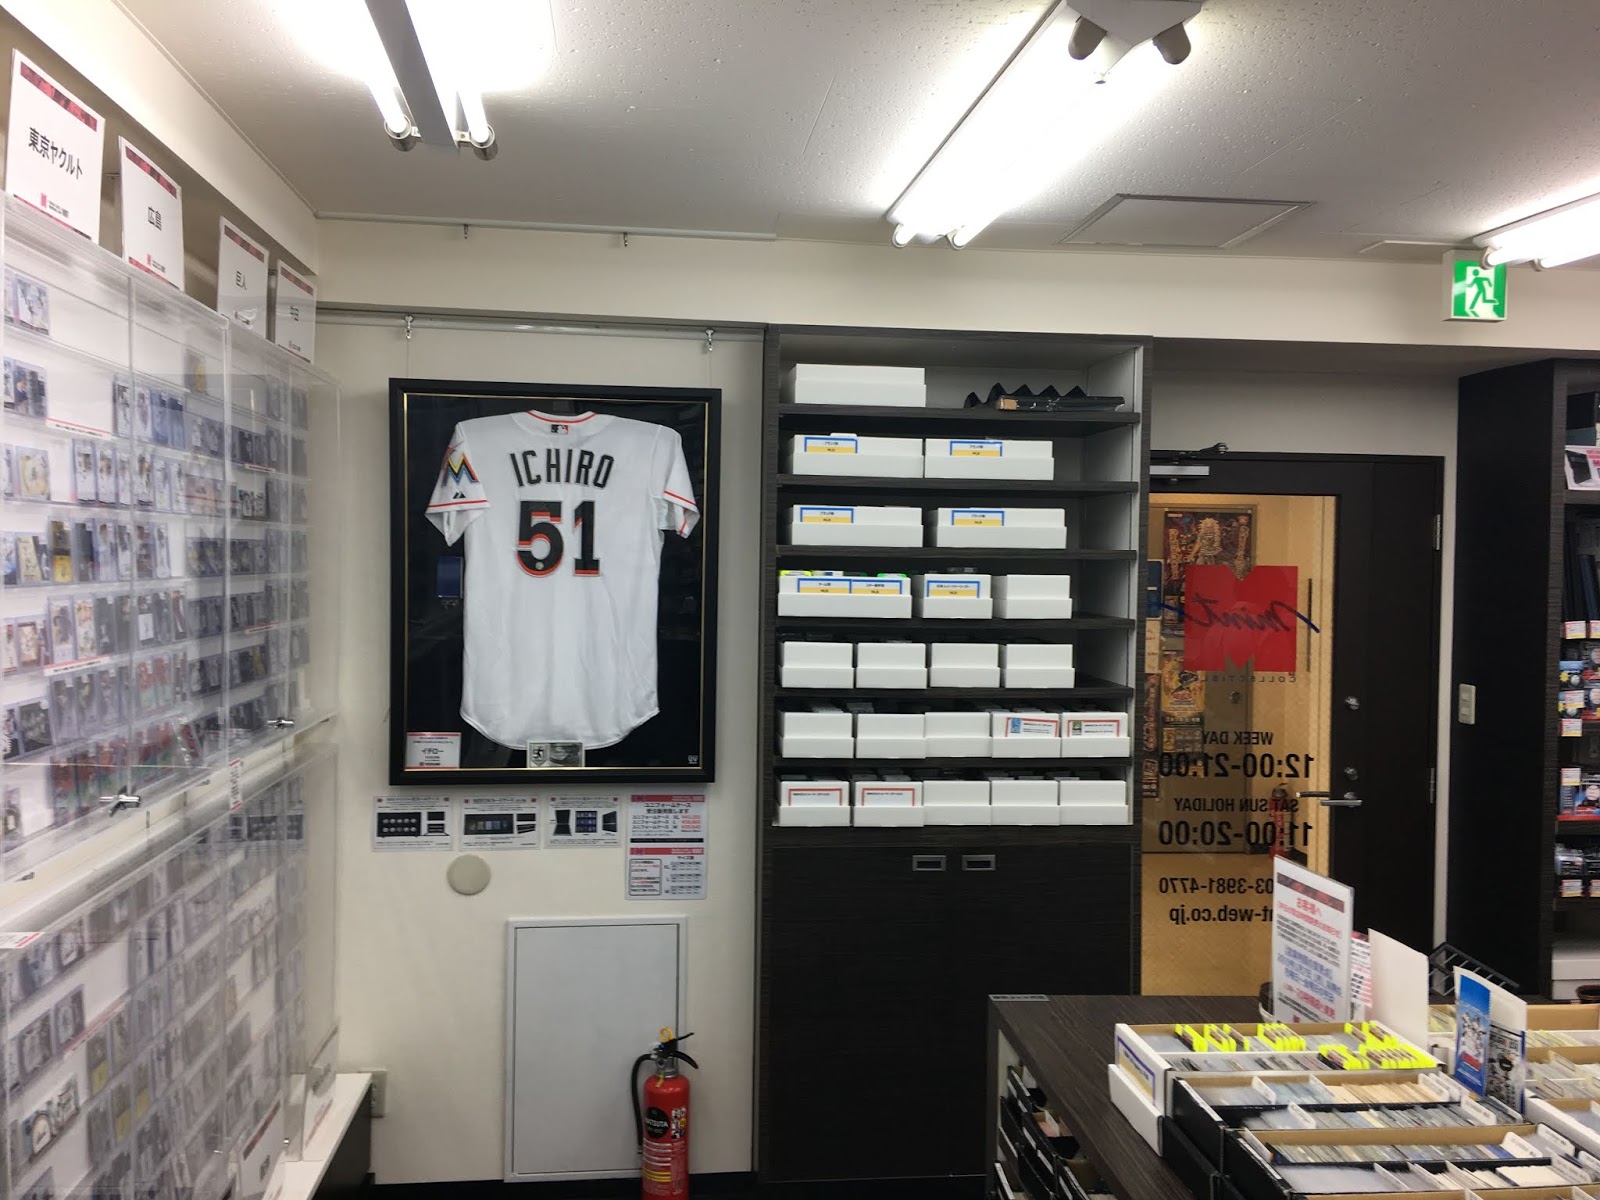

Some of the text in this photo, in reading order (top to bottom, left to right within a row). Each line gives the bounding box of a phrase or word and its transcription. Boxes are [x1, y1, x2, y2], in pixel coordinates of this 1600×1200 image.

[28, 127, 83, 180] 東京ヤクルト
[147, 205, 162, 231] 広島
[510, 448, 615, 490] ICHIRO
[516, 500, 601, 577] 51
